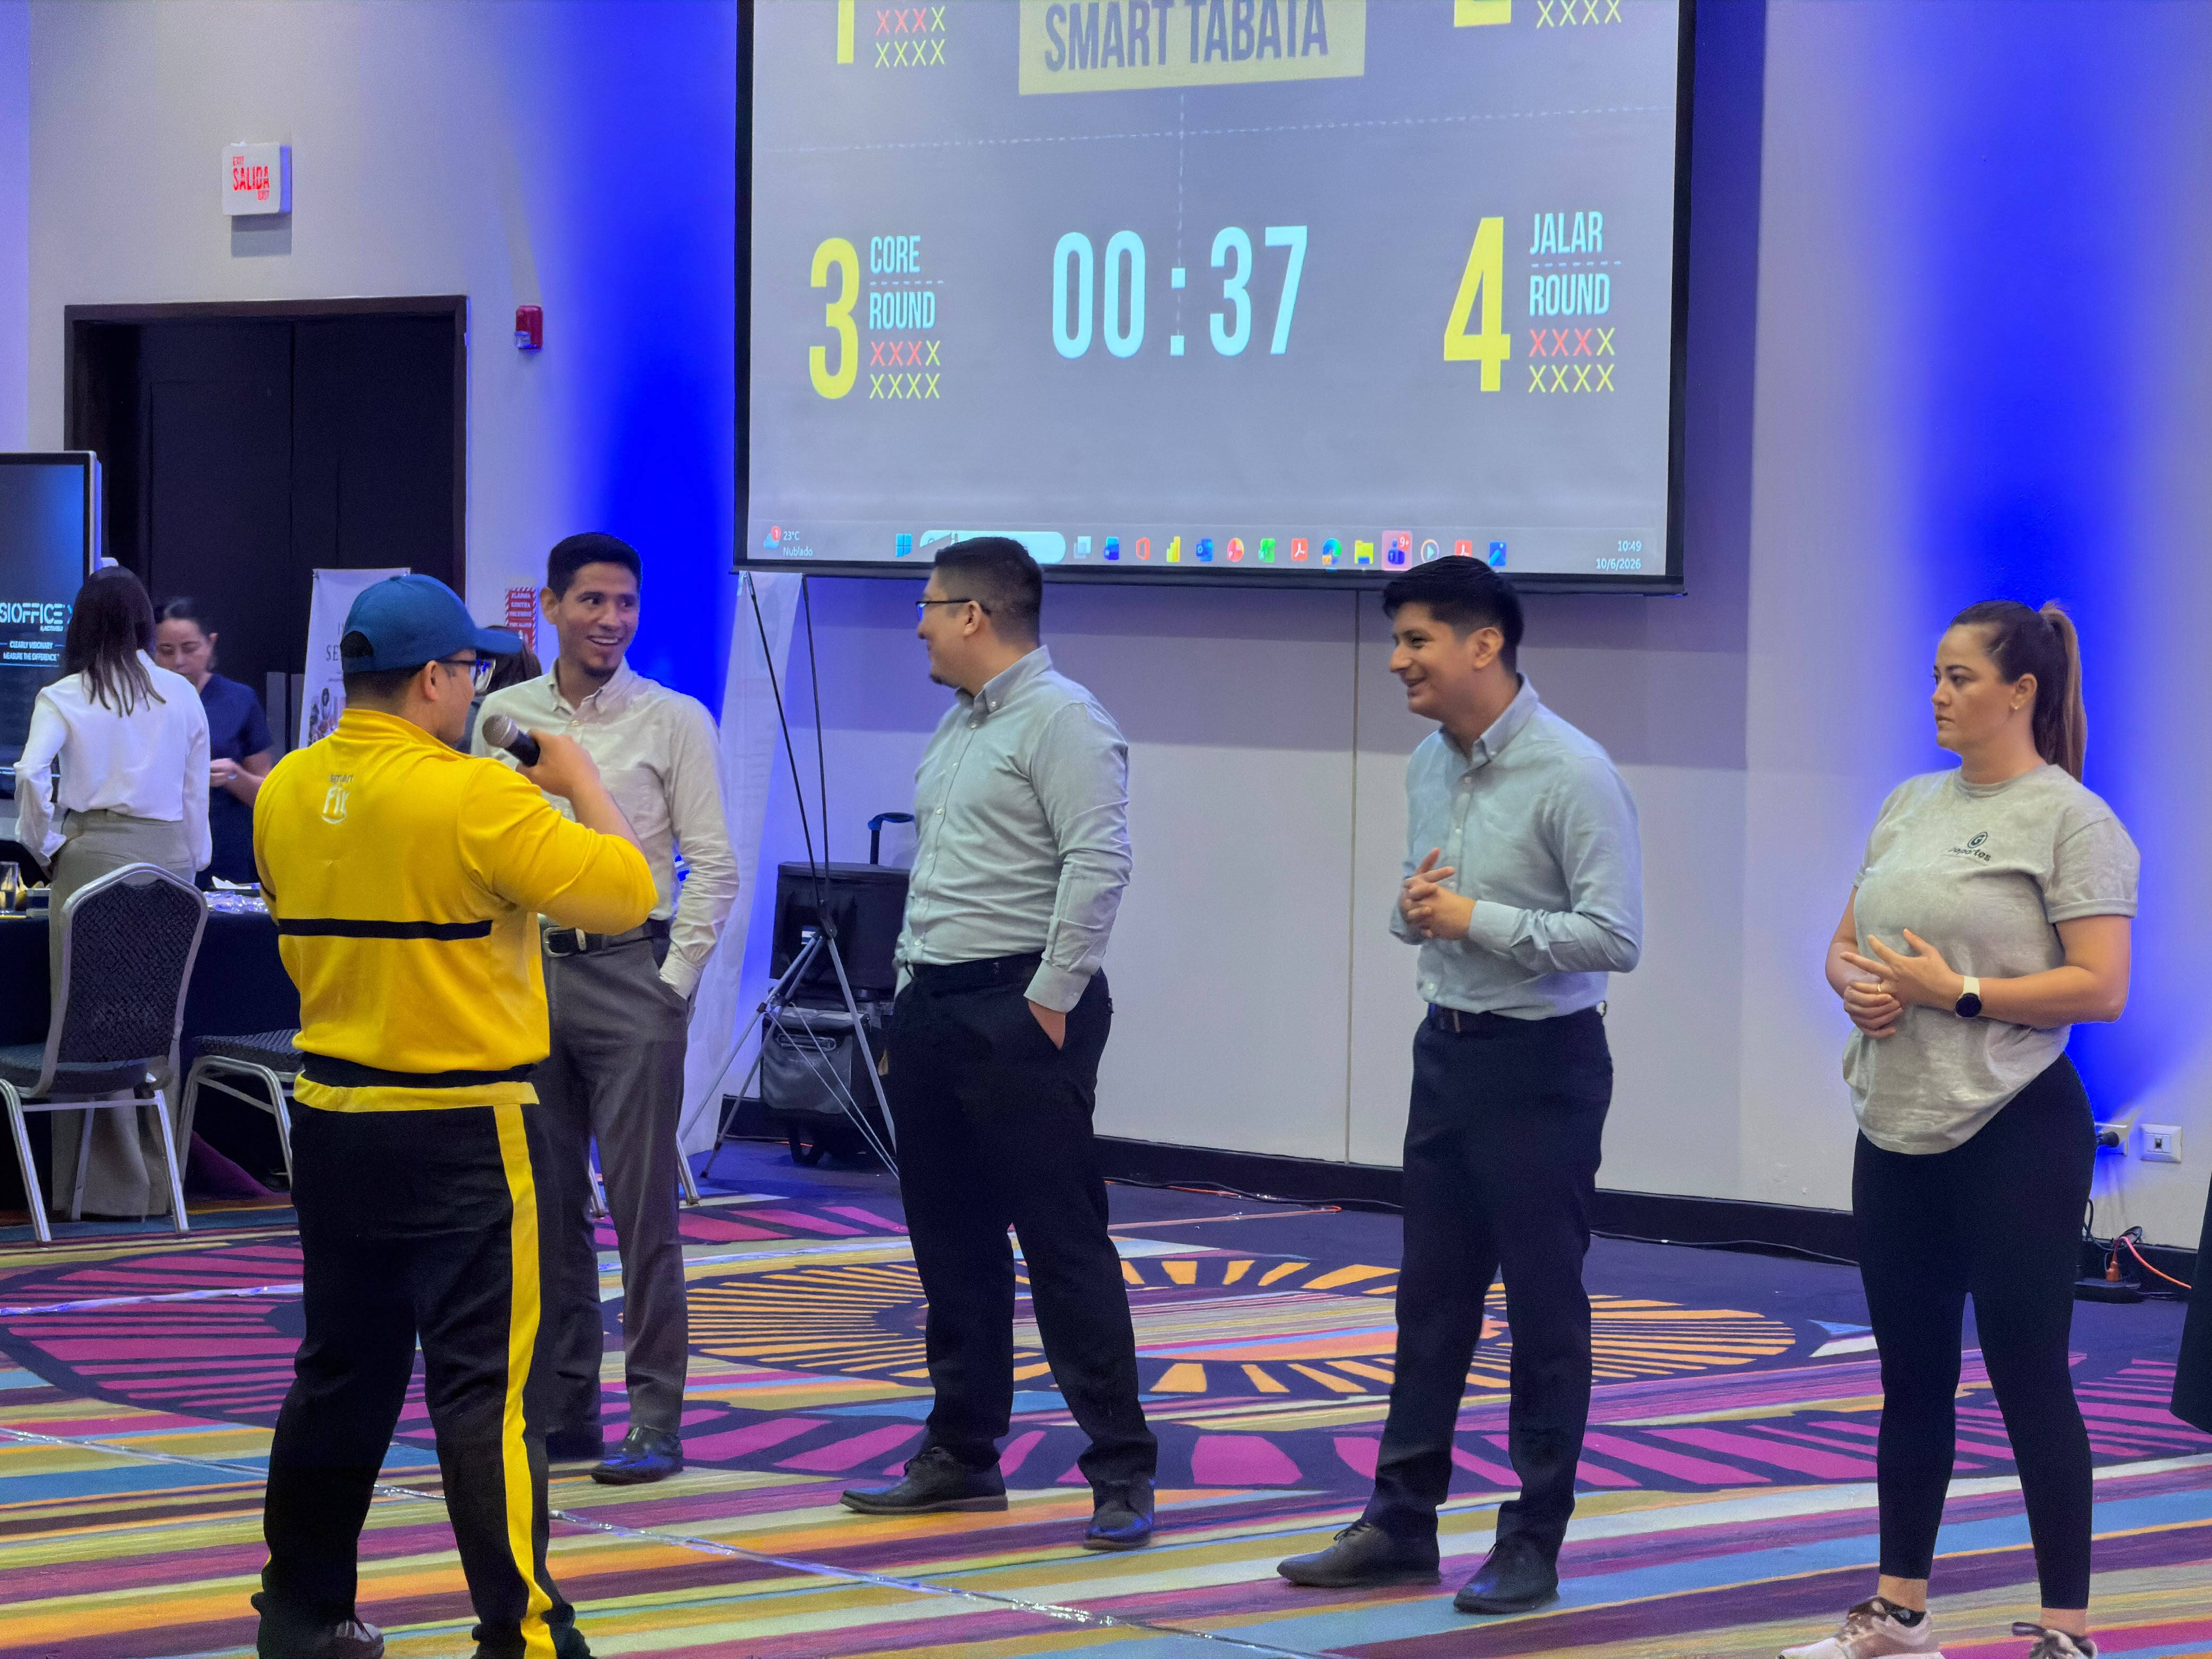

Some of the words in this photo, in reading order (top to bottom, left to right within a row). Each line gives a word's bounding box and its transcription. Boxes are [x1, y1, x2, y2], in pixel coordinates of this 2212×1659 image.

[1044, 0, 1170, 72] SMART
[1185, 0, 1329, 64] TABATA
[232, 166, 270, 191] SALIDA
[1529, 212, 1603, 255] JALAR
[870, 236, 920, 274] CORE
[869, 291, 936, 330] ROUND
[1444, 216, 1511, 391] 4
[1529, 273, 1610, 316] ROUND
[809, 238, 859, 399] 3
[783, 531, 800, 541] 23°C
[783, 546, 813, 556] Nublado
[1618, 540, 1642, 552] 10:49
[1596, 558, 1641, 571] 10/6/2026
